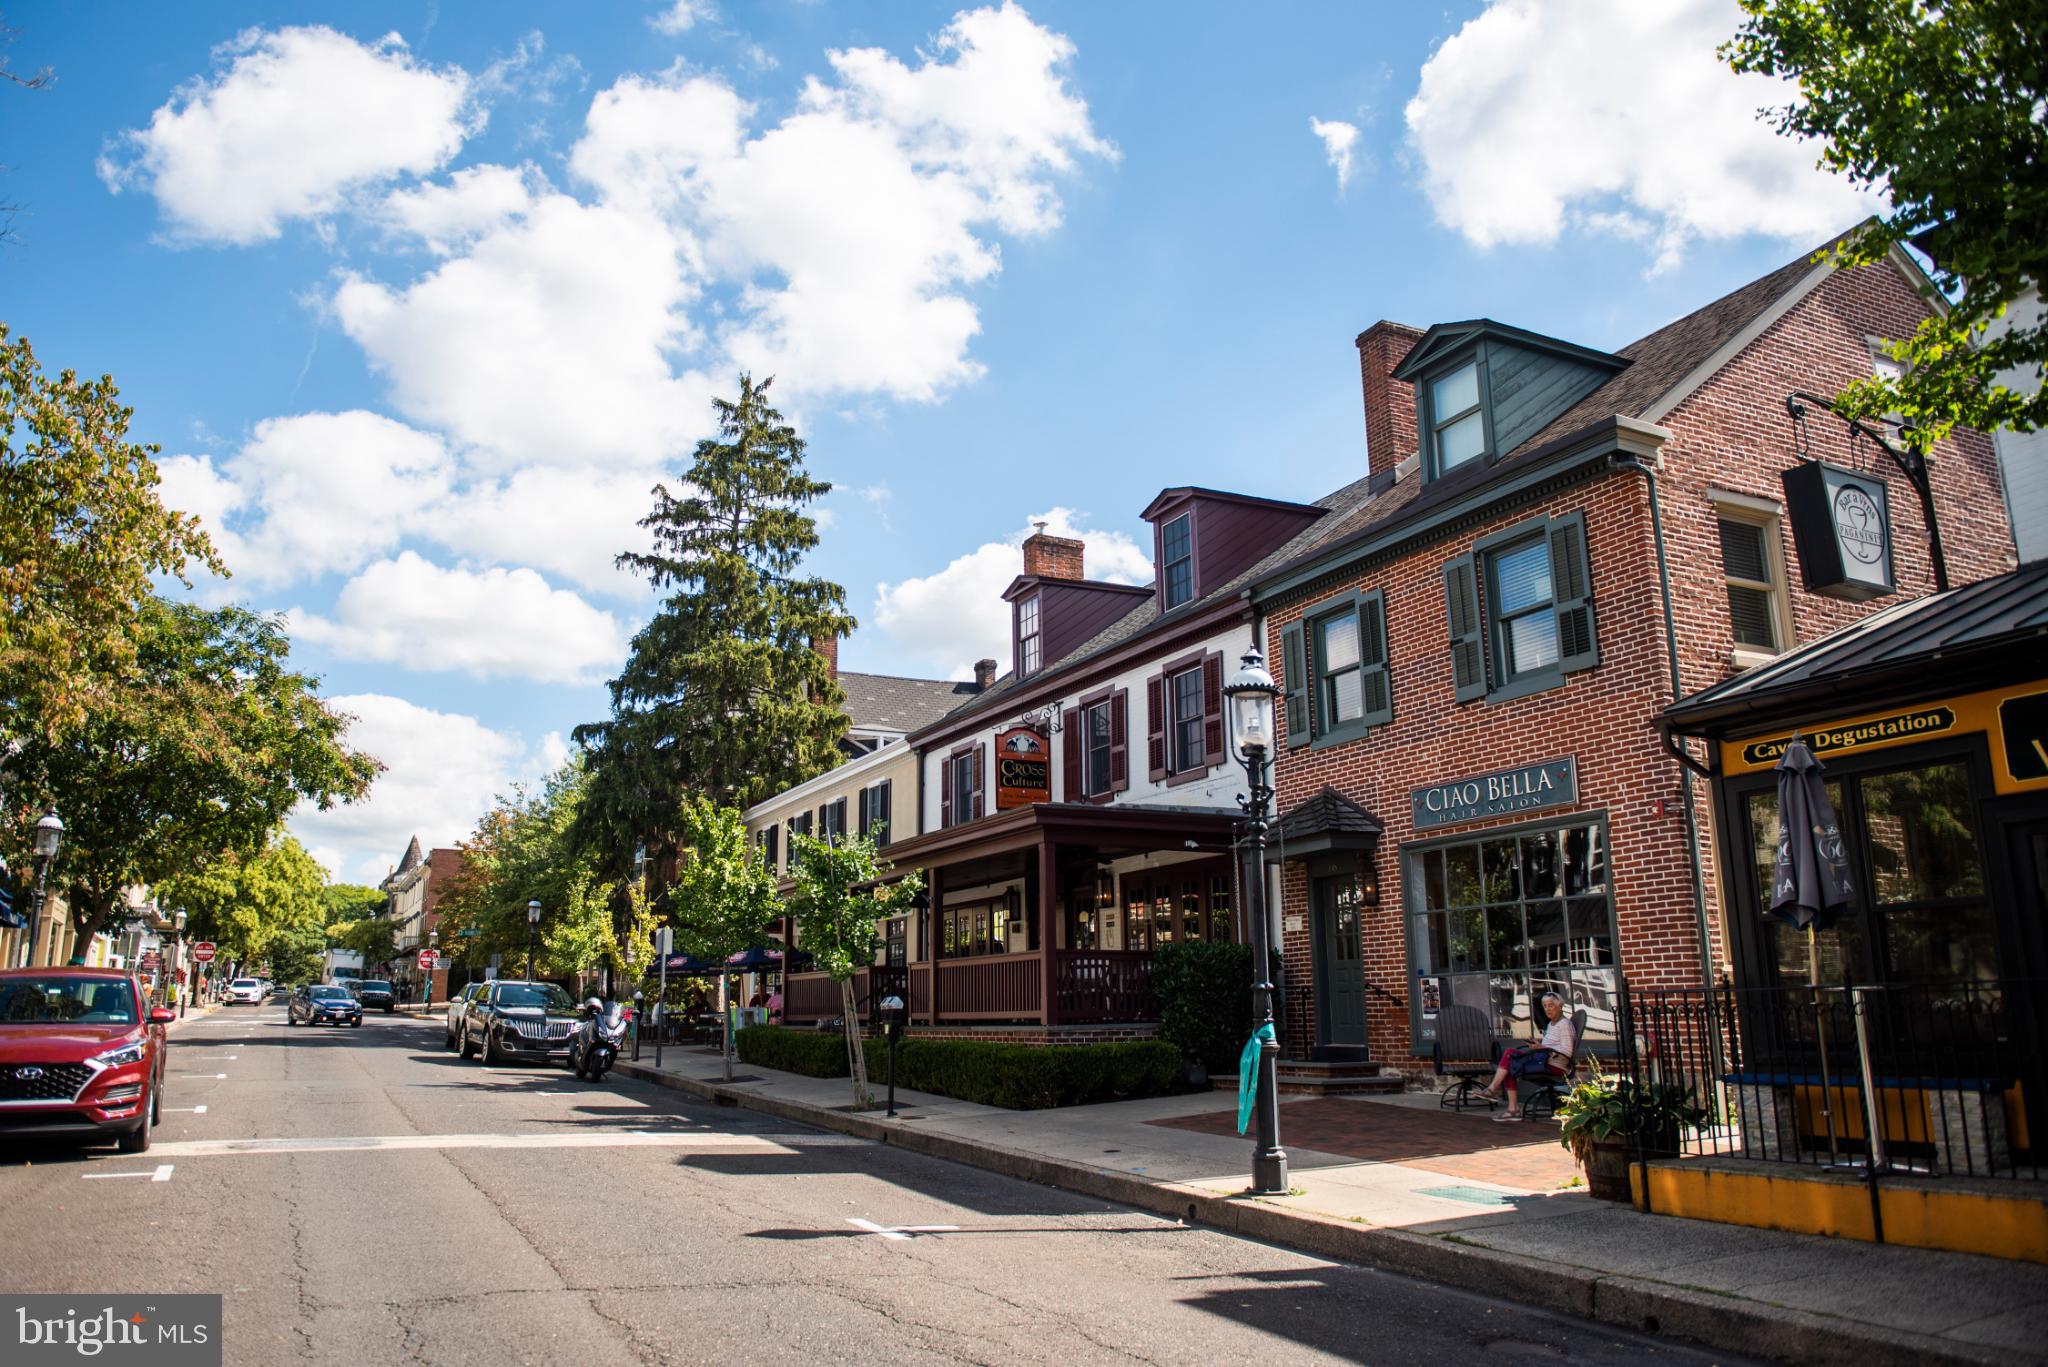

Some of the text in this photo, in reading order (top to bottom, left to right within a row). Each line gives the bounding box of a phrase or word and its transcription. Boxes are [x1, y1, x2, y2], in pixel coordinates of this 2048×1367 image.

[1754, 714, 1941, 758] Cav Degustation
[1001, 760, 1045, 776] CROSS
[1002, 775, 1044, 787] Culture
[1426, 768, 1553, 811] CIAO BELLA
[1439, 797, 1542, 822] HAIR SALON
